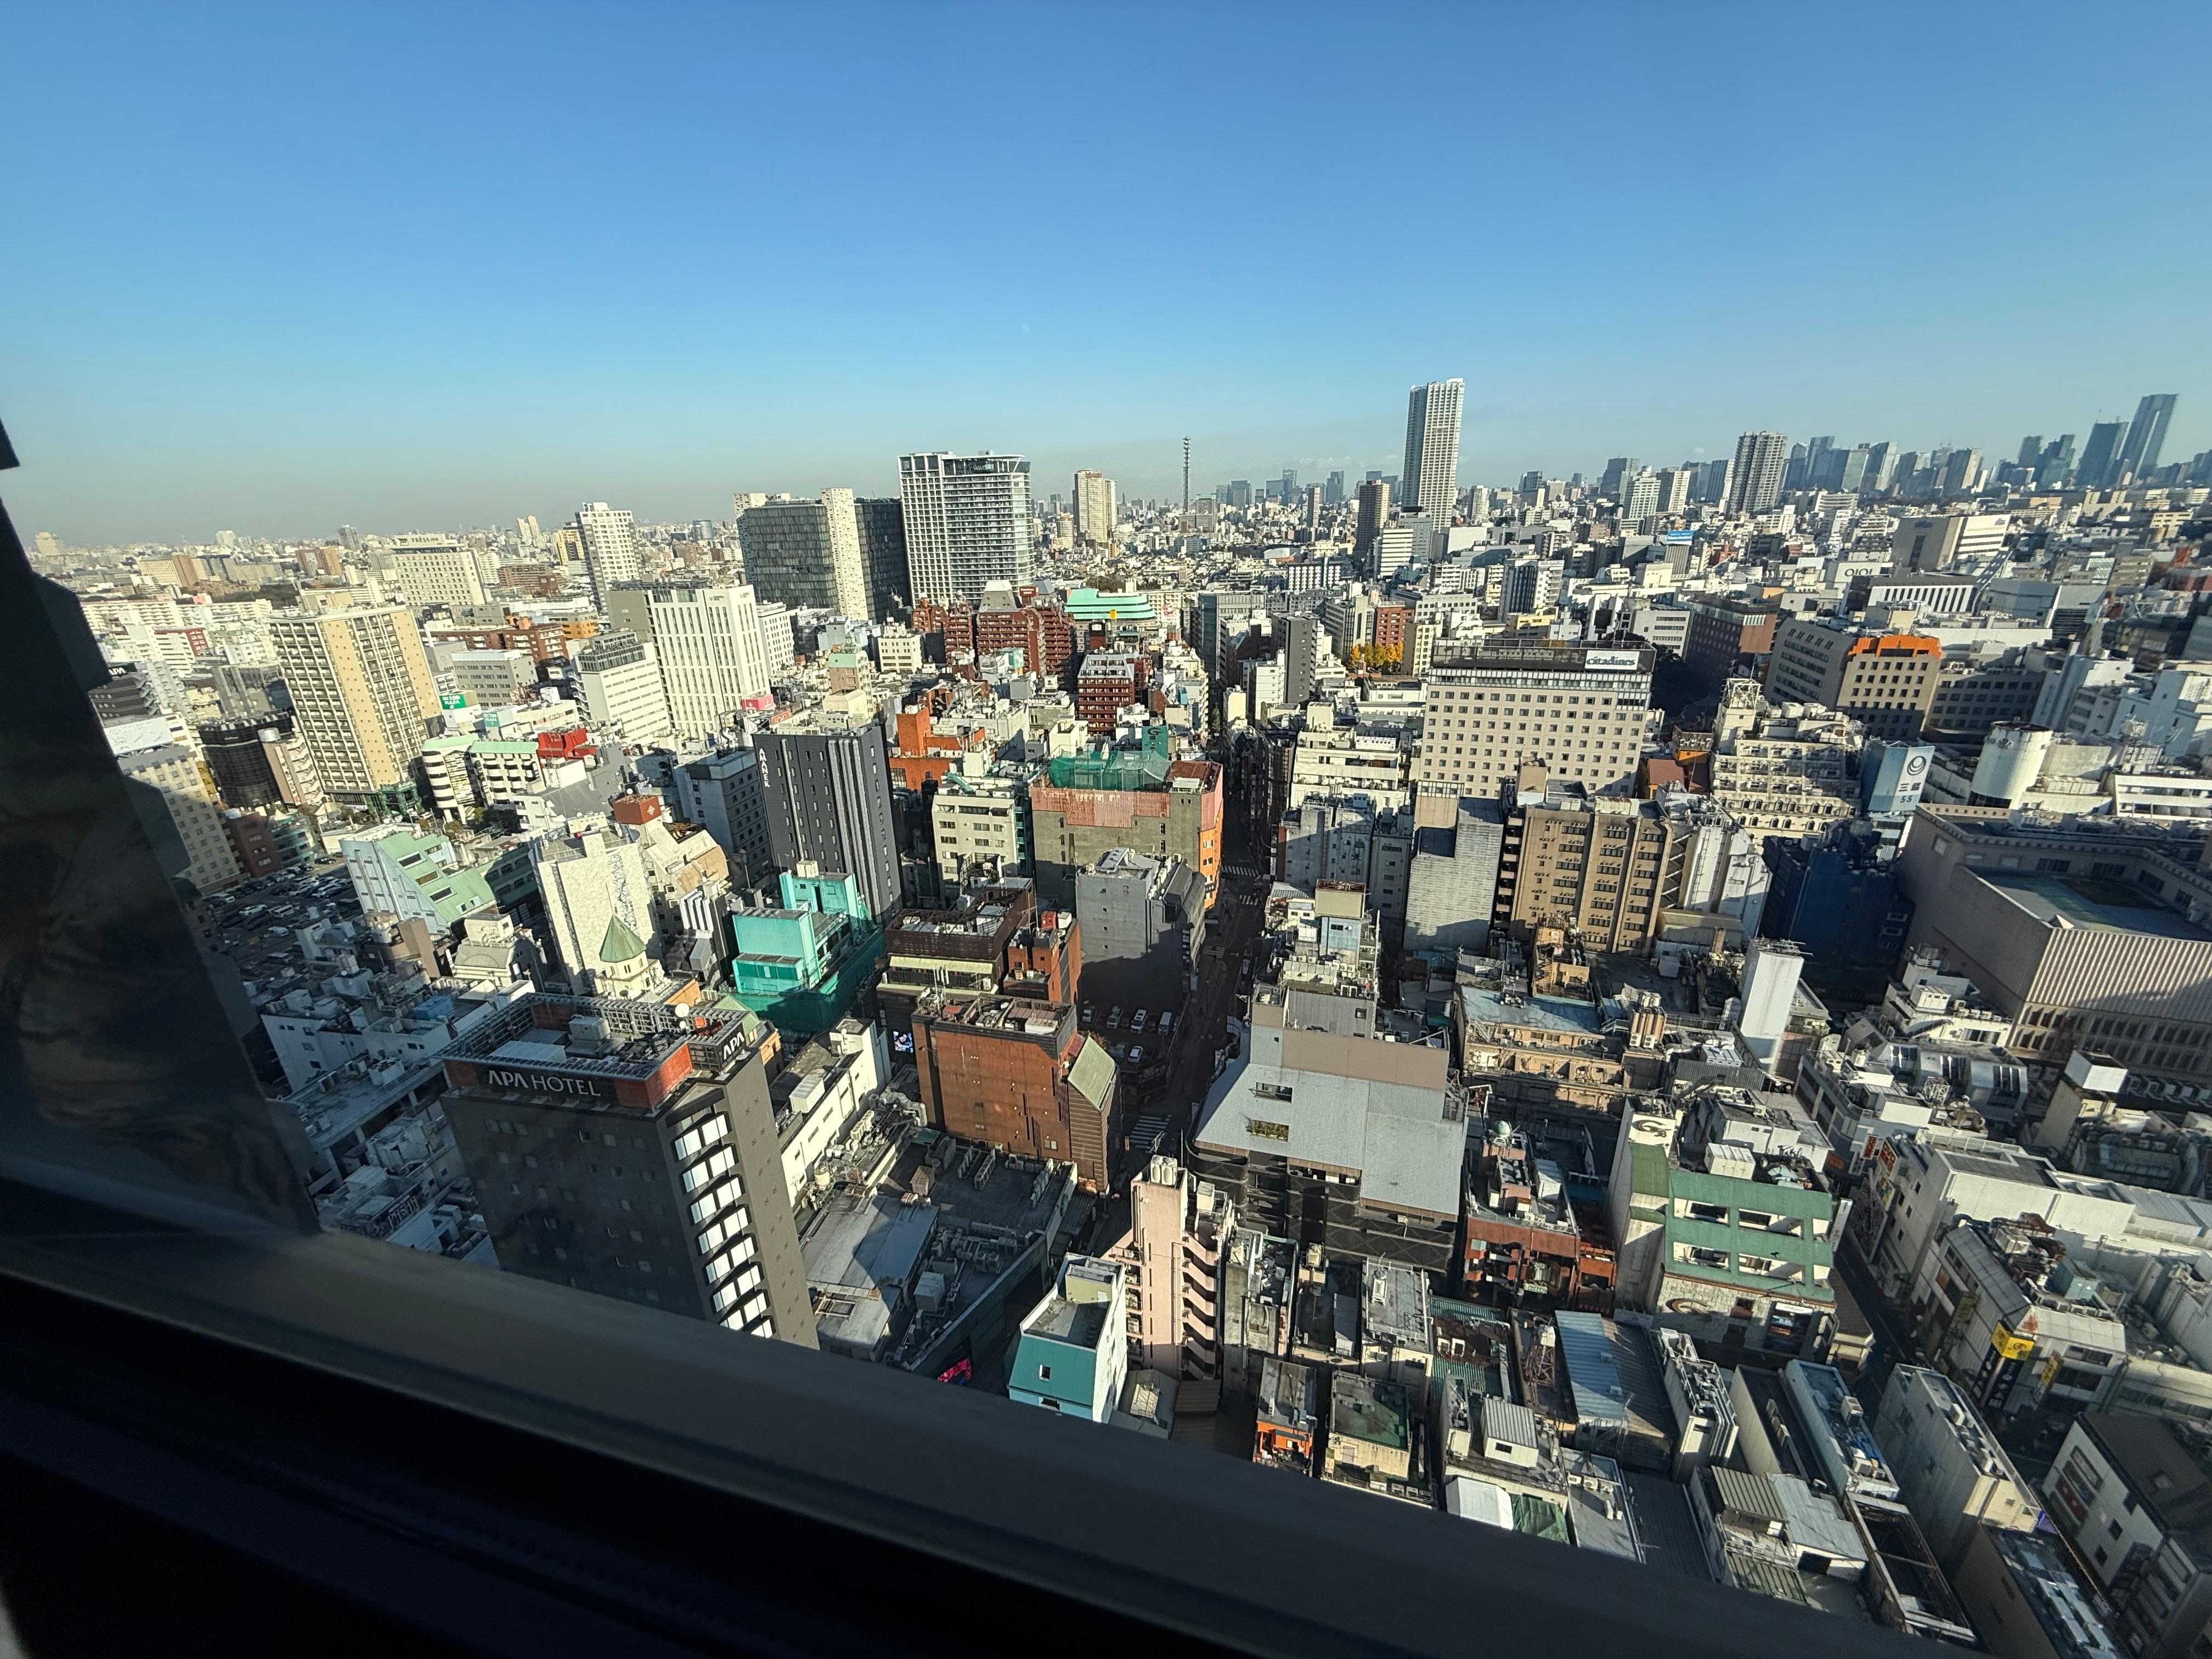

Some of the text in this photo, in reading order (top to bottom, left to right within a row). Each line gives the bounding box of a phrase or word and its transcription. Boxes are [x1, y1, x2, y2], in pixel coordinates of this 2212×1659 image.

[1587, 656, 1635, 665] citadines
[759, 748, 770, 788] AMANEK
[1900, 795, 1914, 804] 55
[723, 1031, 744, 1059] APA
[488, 1070, 600, 1097] APA HOTEL
